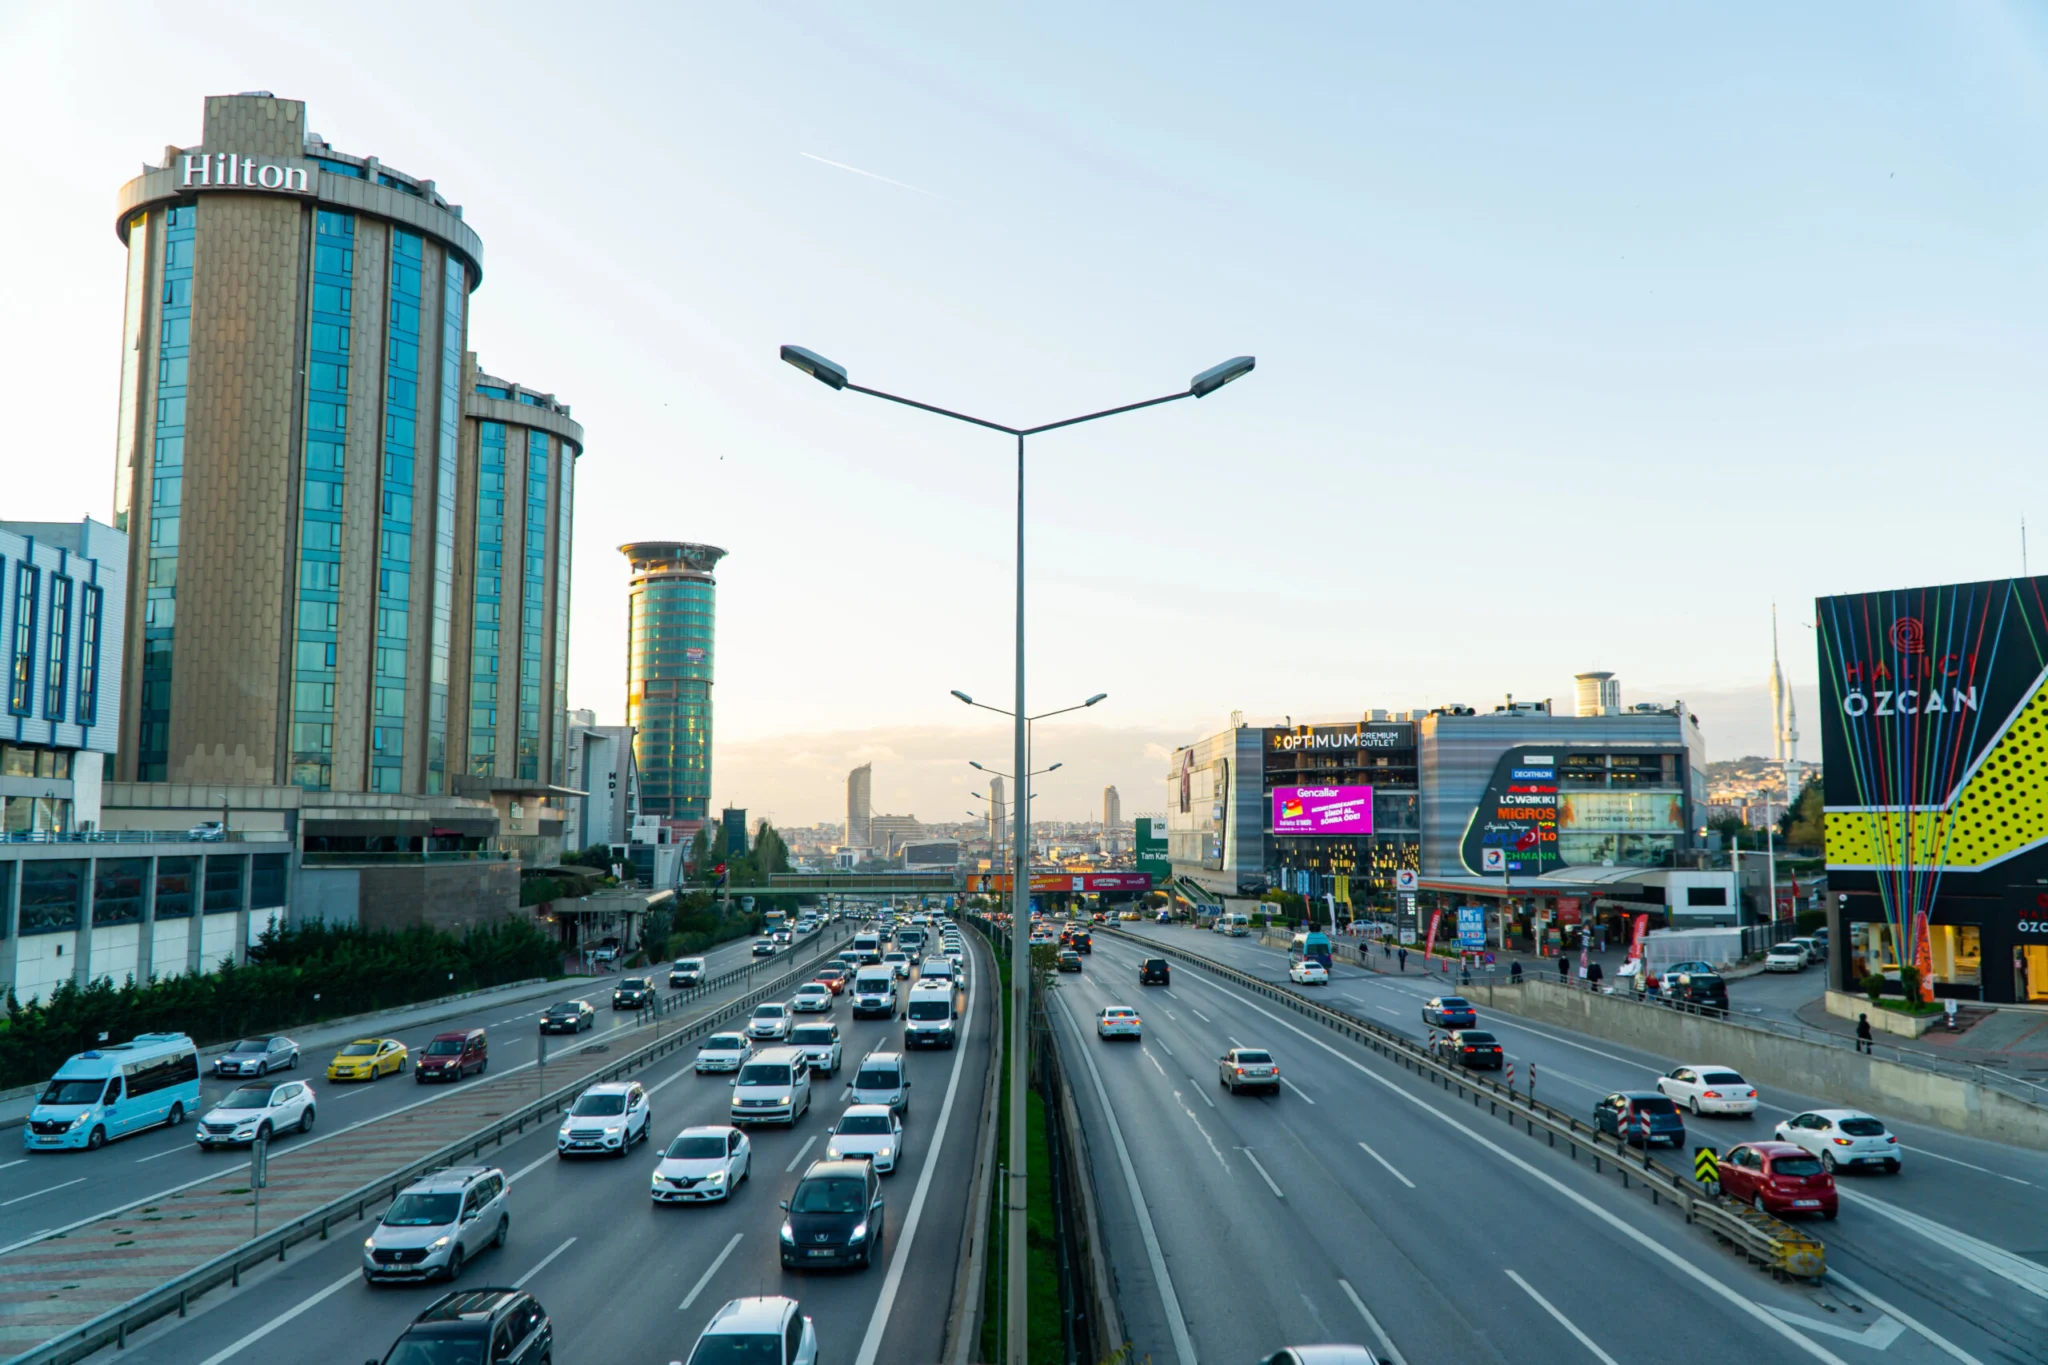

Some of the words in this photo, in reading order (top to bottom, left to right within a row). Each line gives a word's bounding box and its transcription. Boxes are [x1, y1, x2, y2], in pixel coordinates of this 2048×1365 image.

[183, 153, 308, 192] Hilton
[1846, 653, 1976, 682] HALICI
[1843, 686, 1977, 717] ÖZCAN
[1283, 733, 1358, 750] OPTIMUM
[1360, 739, 1395, 747] OUTLET
[608, 772, 616, 799] HDI
[1297, 788, 1339, 798] Gencallar
[1141, 852, 1155, 860] Tam
[1504, 851, 1556, 860] CHMANN
